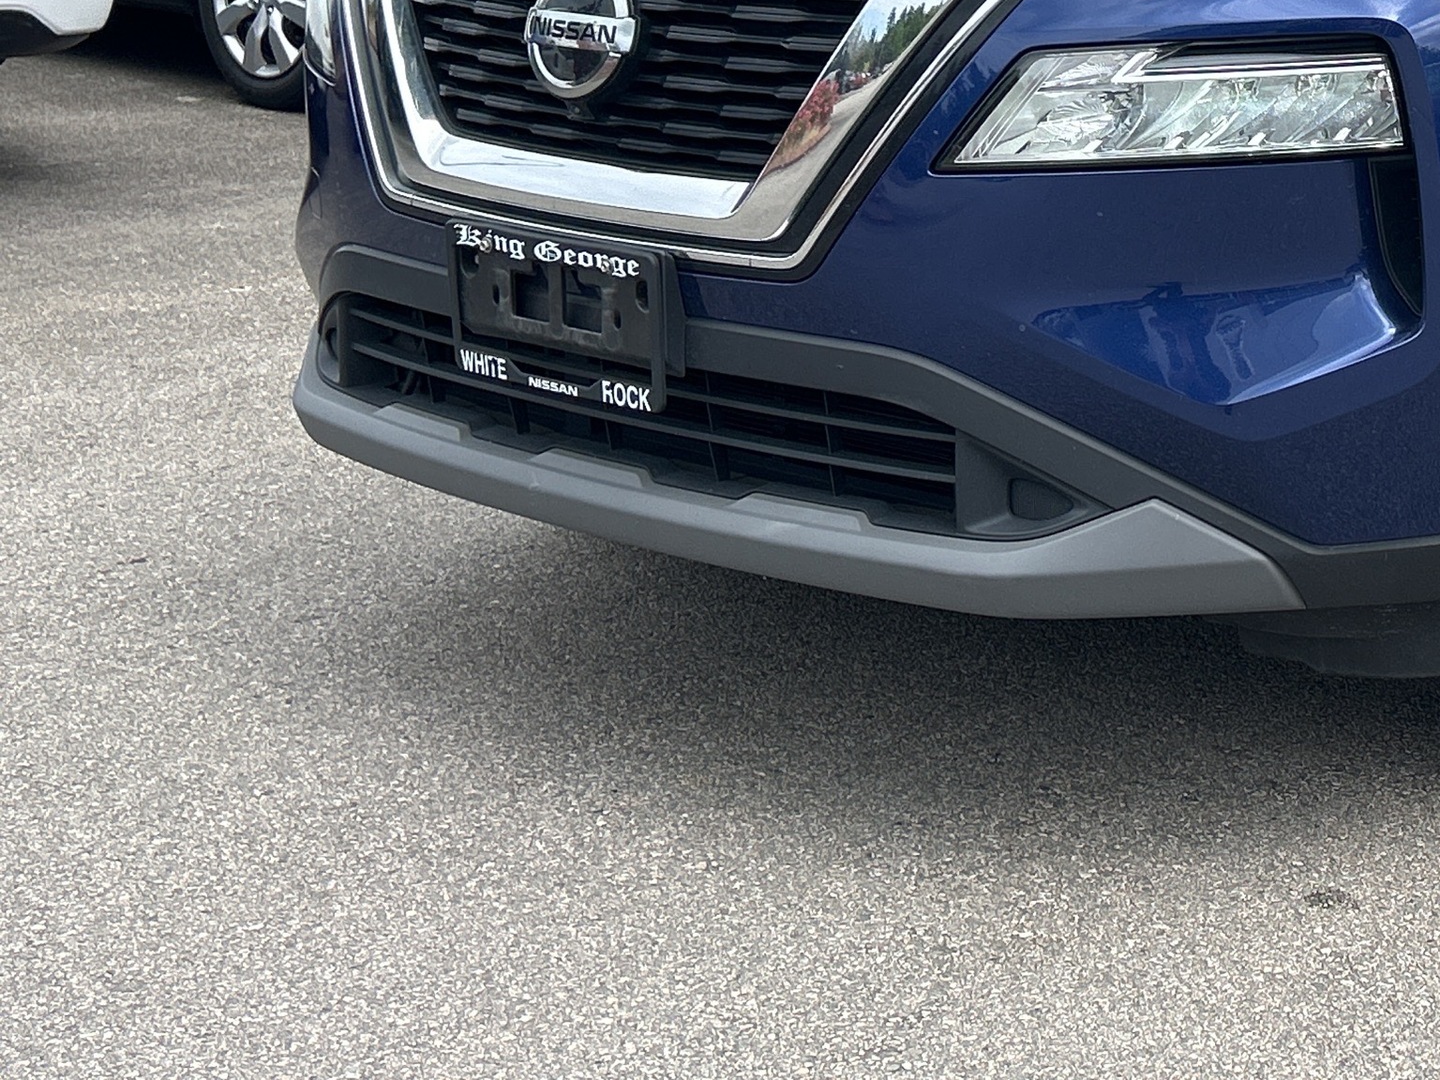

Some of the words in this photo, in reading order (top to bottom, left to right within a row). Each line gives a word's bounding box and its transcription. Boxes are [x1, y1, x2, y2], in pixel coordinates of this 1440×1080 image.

[531, 15, 618, 44] NISSAN
[533, 240, 640, 278] George
[460, 349, 508, 380] WHITE
[528, 376, 579, 397] NISSAN
[601, 379, 652, 412] ROCK
